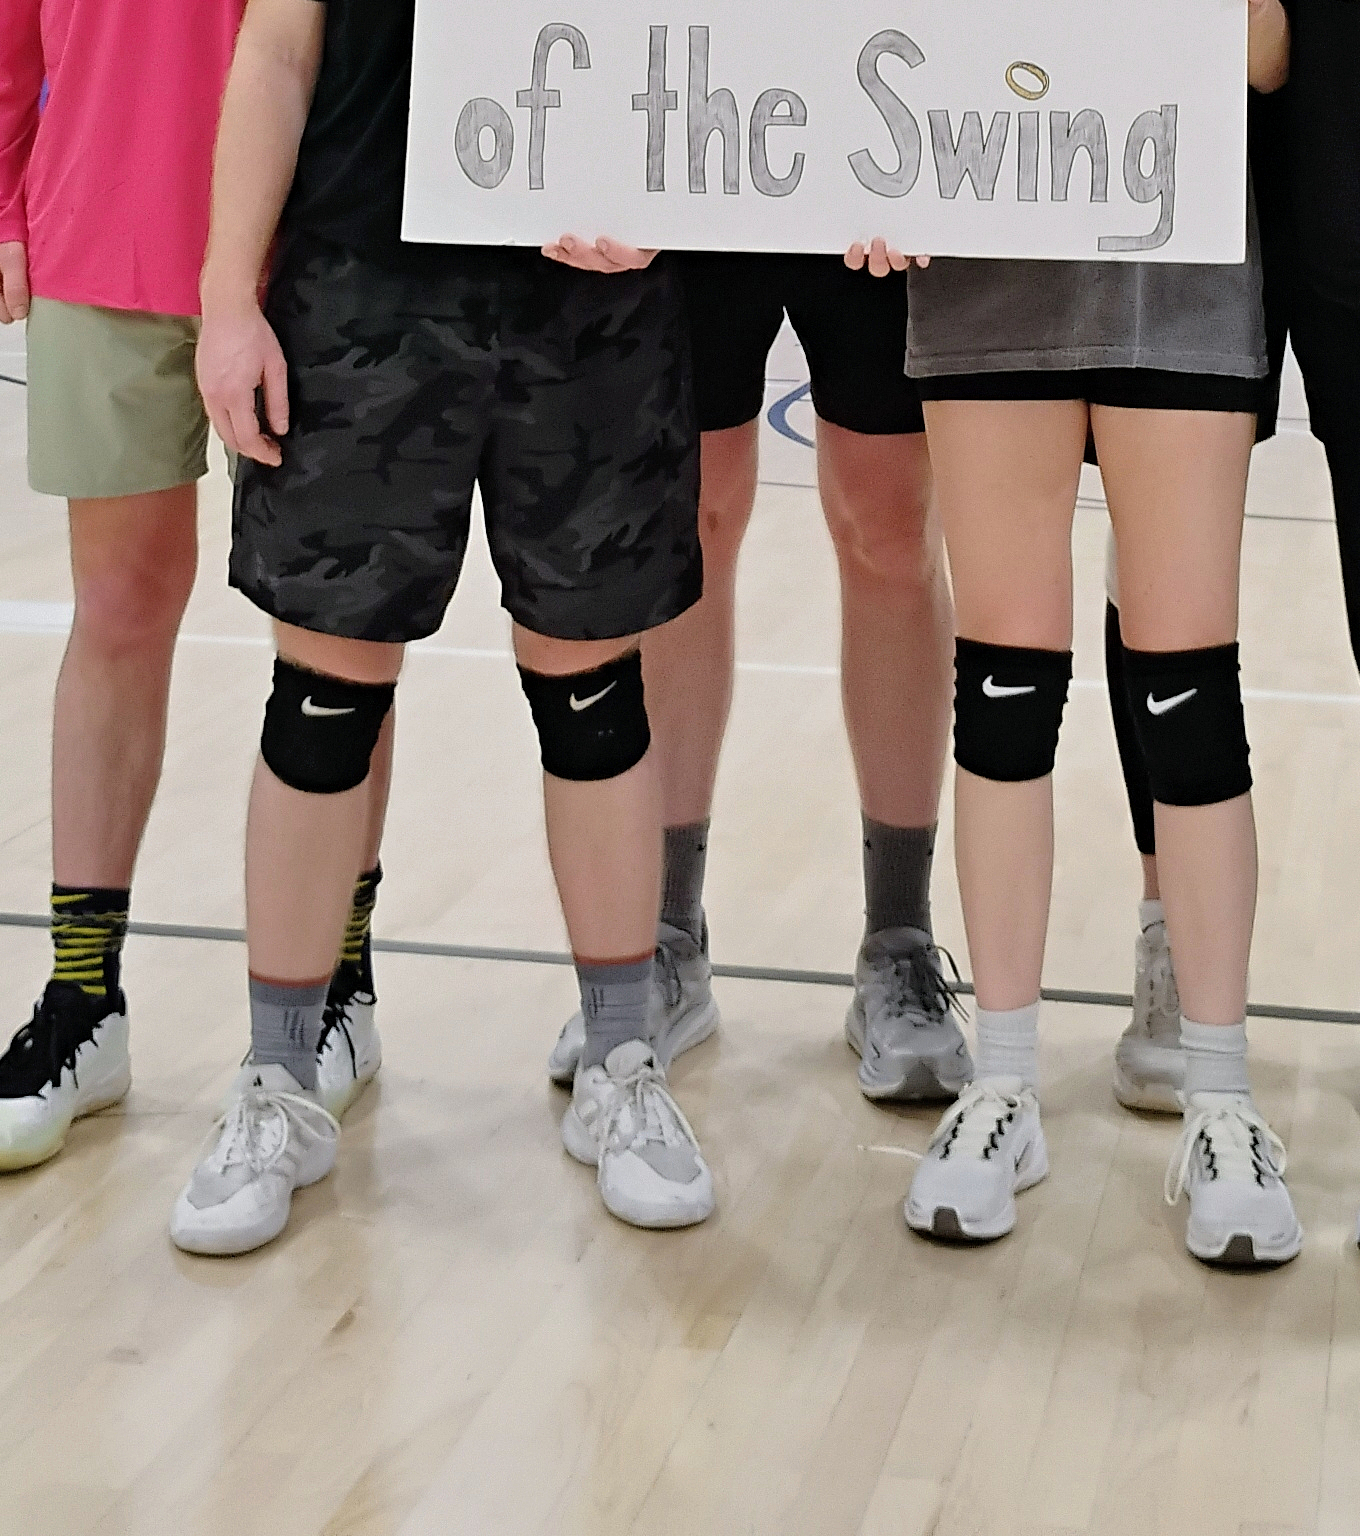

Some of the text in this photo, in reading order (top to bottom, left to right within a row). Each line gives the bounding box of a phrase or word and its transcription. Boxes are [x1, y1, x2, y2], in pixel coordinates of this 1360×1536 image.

[454, 22, 1178, 253] of the Swing
